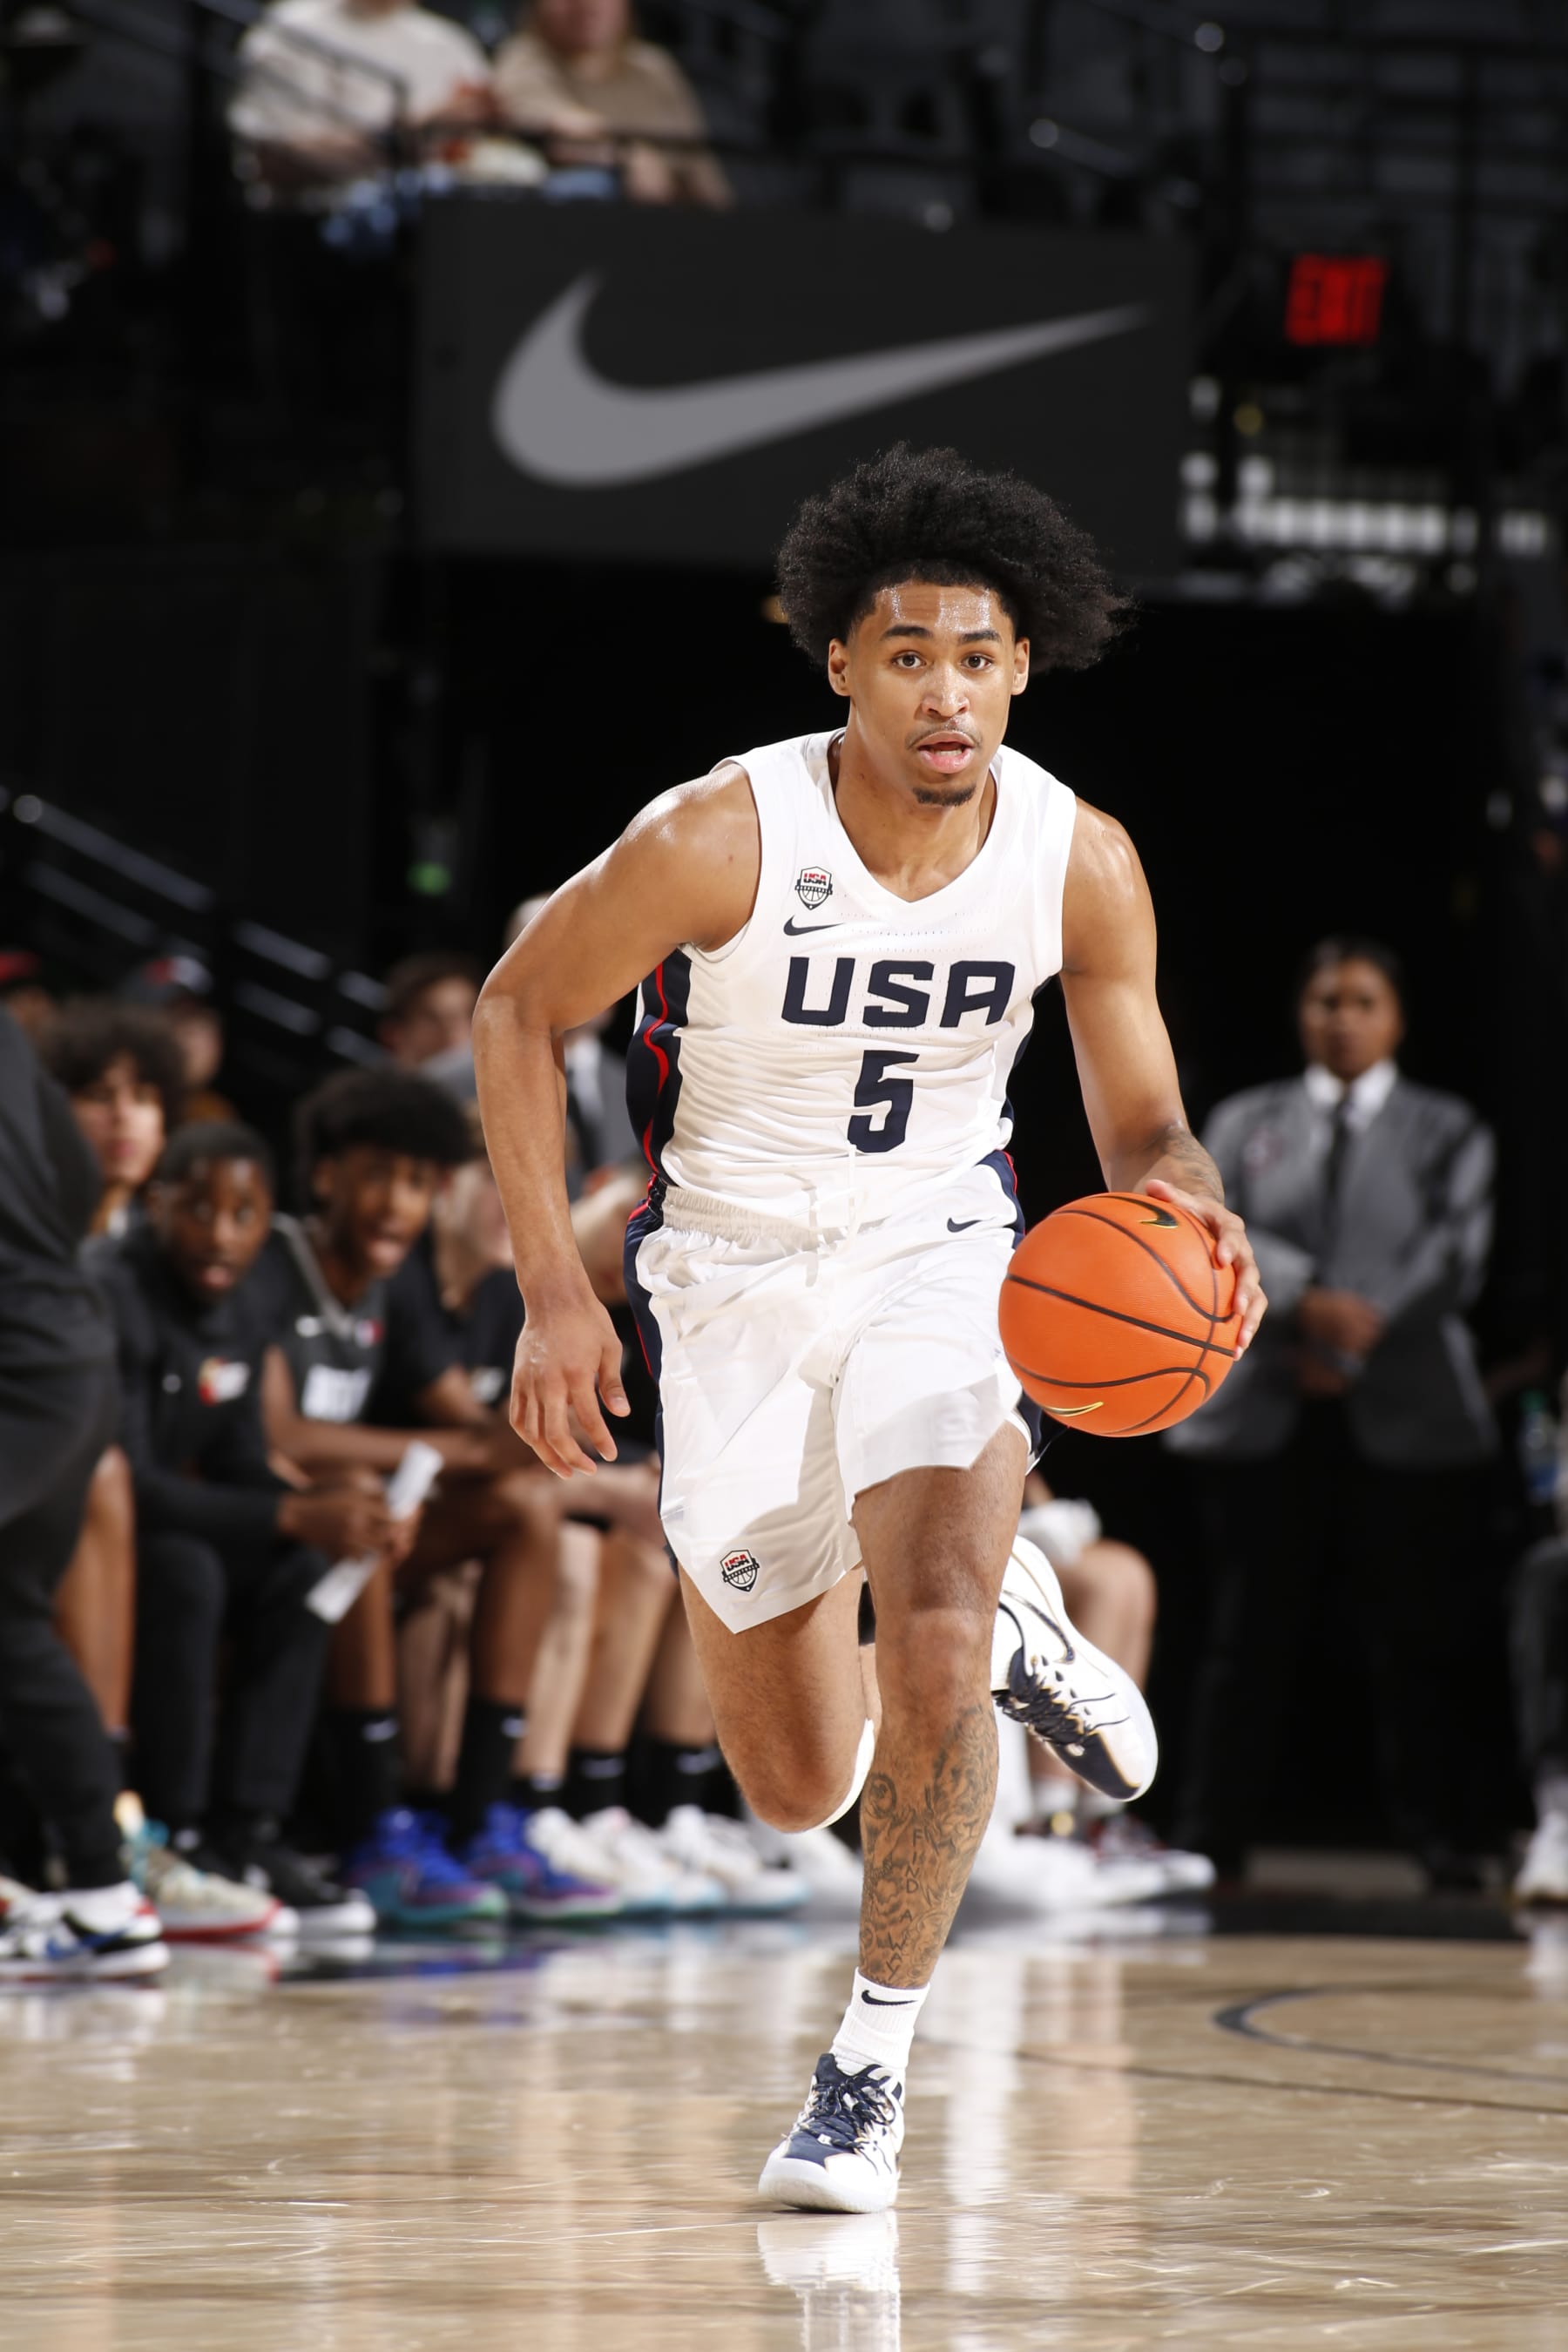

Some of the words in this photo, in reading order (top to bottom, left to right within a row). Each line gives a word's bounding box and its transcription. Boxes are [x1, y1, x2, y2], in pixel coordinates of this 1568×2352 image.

[803, 872, 827, 886] USA
[781, 956, 1016, 1028] USA
[847, 1049, 920, 1153] 5
[725, 1554, 750, 1571] USA
[905, 1828, 924, 1894] FIND
